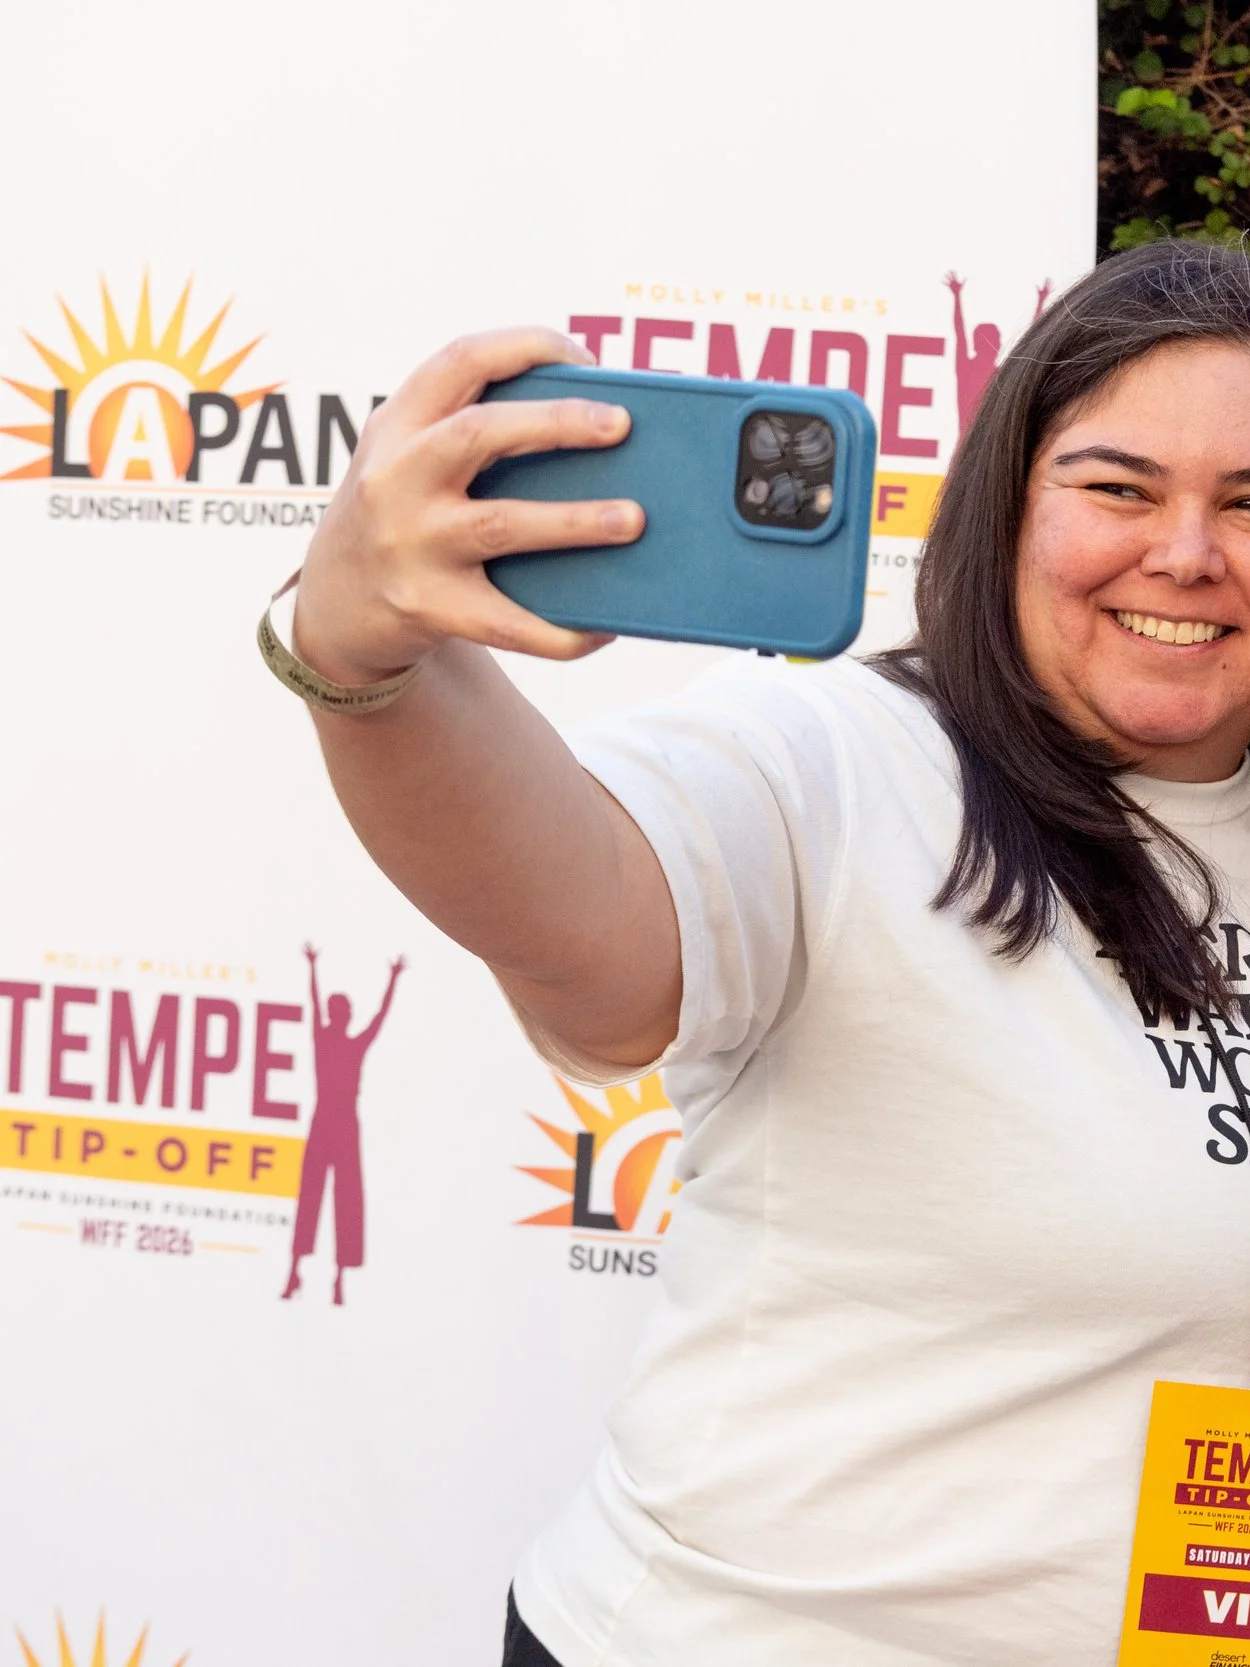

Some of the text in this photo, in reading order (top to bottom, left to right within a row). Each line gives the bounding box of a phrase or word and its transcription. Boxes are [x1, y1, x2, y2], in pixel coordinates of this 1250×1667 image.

[625, 283, 888, 316] MOLLY MILLER'S
[48, 494, 192, 524] SUNSHINE
[0, 980, 304, 1121] TEMPE
[11, 1122, 275, 1180] TIP-OFF
[80, 1218, 194, 1256] WFF 2026
[1206, 1429, 1239, 1438] MOLLY
[1207, 1512, 1245, 1520] SUNSHINE
[1215, 1521, 1235, 1532] WFF
[1210, 1650, 1246, 1663] desert
